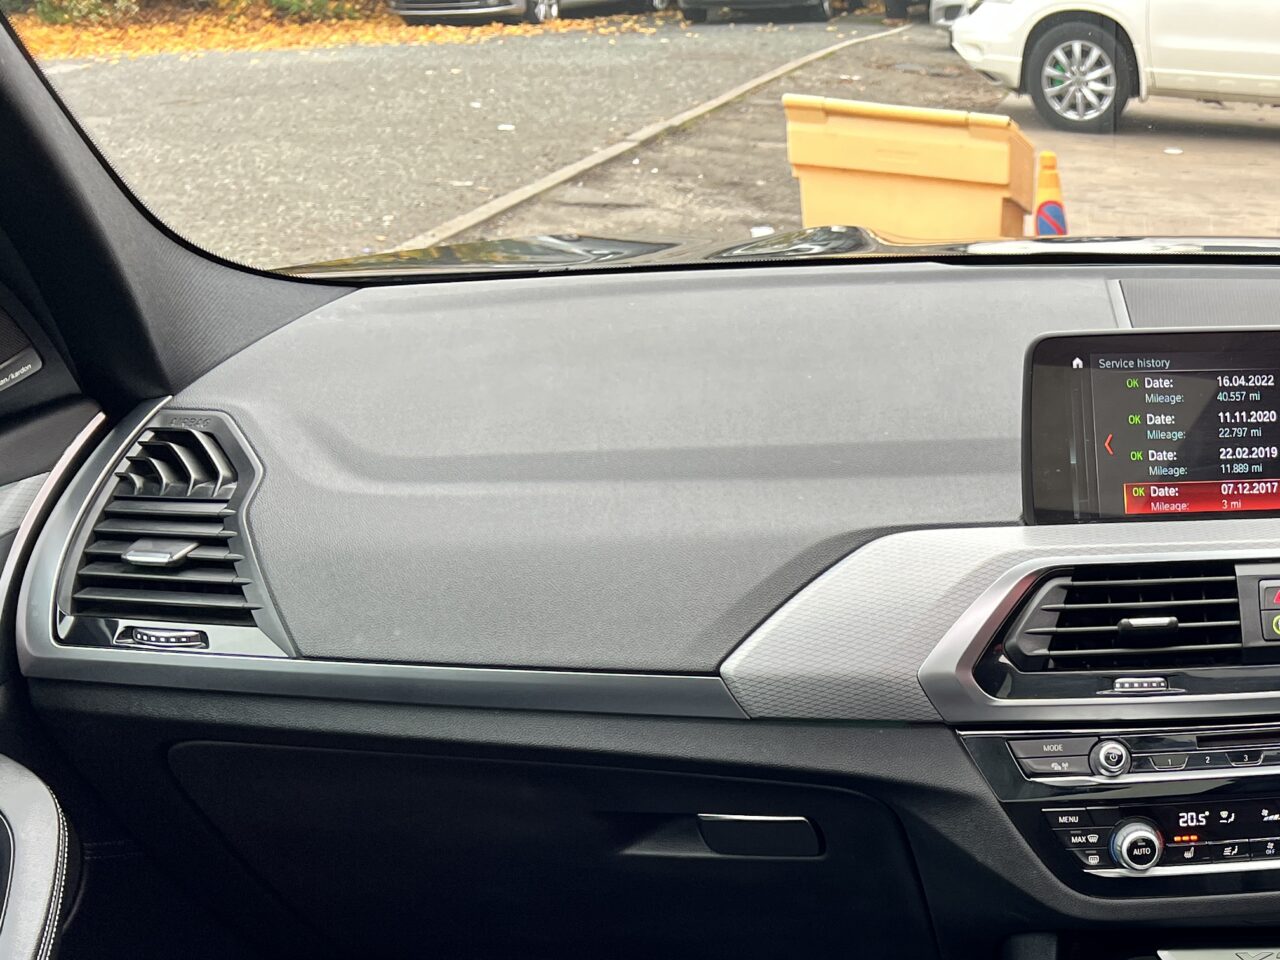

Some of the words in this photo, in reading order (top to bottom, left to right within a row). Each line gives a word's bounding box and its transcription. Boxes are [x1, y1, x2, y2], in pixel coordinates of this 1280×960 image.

[1099, 358, 1135, 369] Service
[1137, 358, 1171, 370] history
[1126, 378, 1139, 389] OK
[1144, 377, 1174, 389] Date:
[1216, 374, 1275, 387] 16.04.2022
[1145, 393, 1185, 405] Mileage:
[1216, 391, 1246, 402] 40.557
[1249, 391, 1261, 401] mi
[1128, 414, 1141, 425] OK
[1146, 413, 1175, 425] Date:
[1218, 410, 1277, 423] 11.11.2020
[1147, 429, 1186, 441] Mileage:
[1218, 427, 1248, 438] 22.797
[1250, 427, 1262, 437] mi
[1130, 451, 1143, 461] OK
[1148, 450, 1177, 461] Date:
[1219, 446, 1278, 459] 22.02.2019
[1149, 465, 1188, 477] Mileage:
[1220, 463, 1249, 474] 11.889
[1251, 462, 1263, 473] mi
[1132, 486, 1145, 497] OK
[1150, 485, 1179, 497] Date:
[1221, 482, 1279, 495] 07.12.2017
[1151, 501, 1189, 511] Mileage:
[1221, 499, 1228, 509] 3
[1230, 498, 1241, 509] mi
[1043, 744, 1064, 752] MODE
[1058, 815, 1079, 824] MENU
[1071, 835, 1087, 844] MAX
[1132, 846, 1151, 856] AUTO
